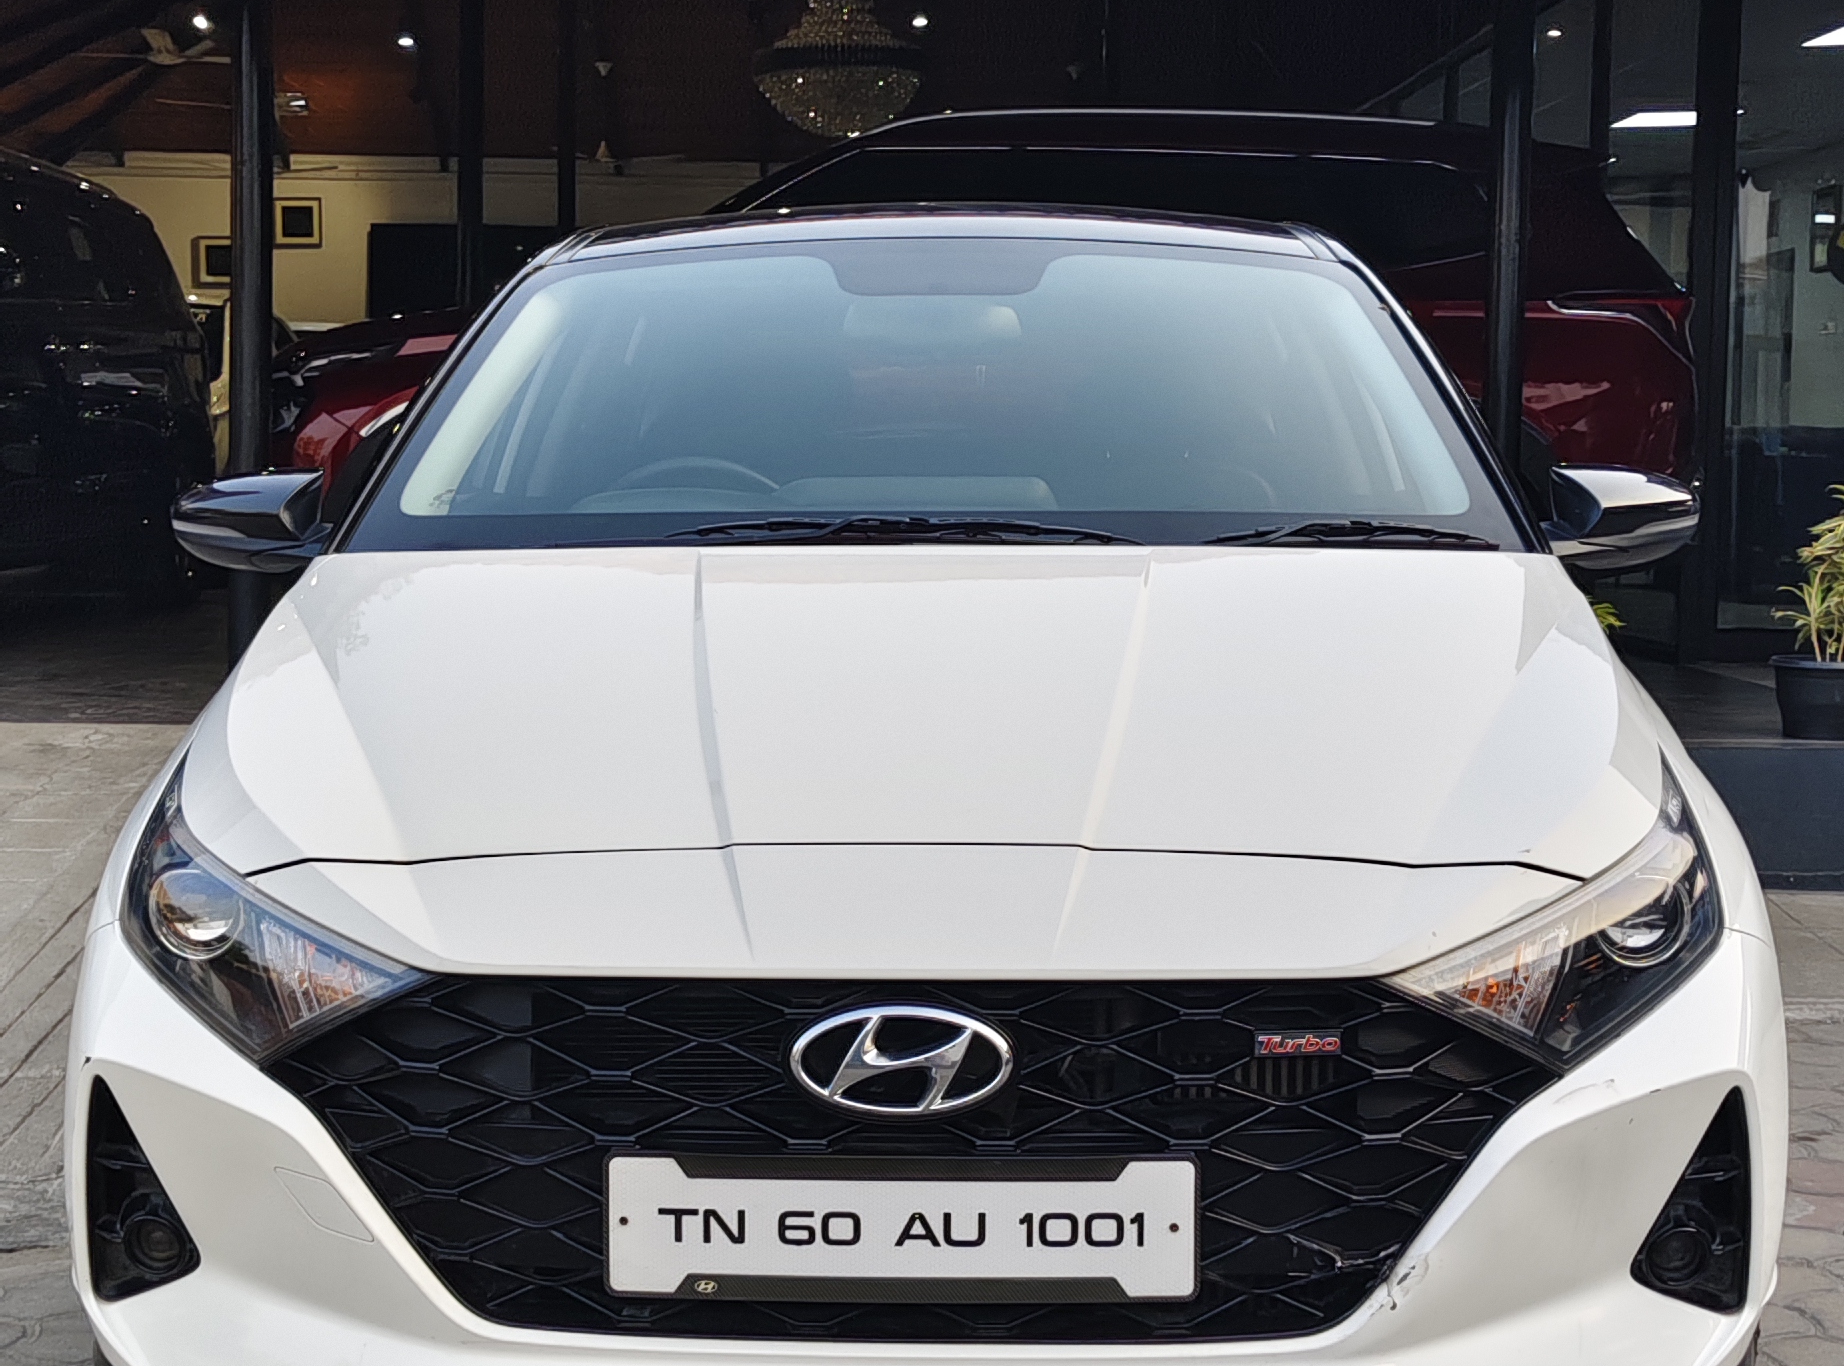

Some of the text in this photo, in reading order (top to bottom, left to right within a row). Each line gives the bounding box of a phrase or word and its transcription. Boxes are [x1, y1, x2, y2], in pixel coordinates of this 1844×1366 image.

[1258, 1034, 1340, 1054] Turbo
[658, 1207, 1145, 1248] TN 60 AU 1001
